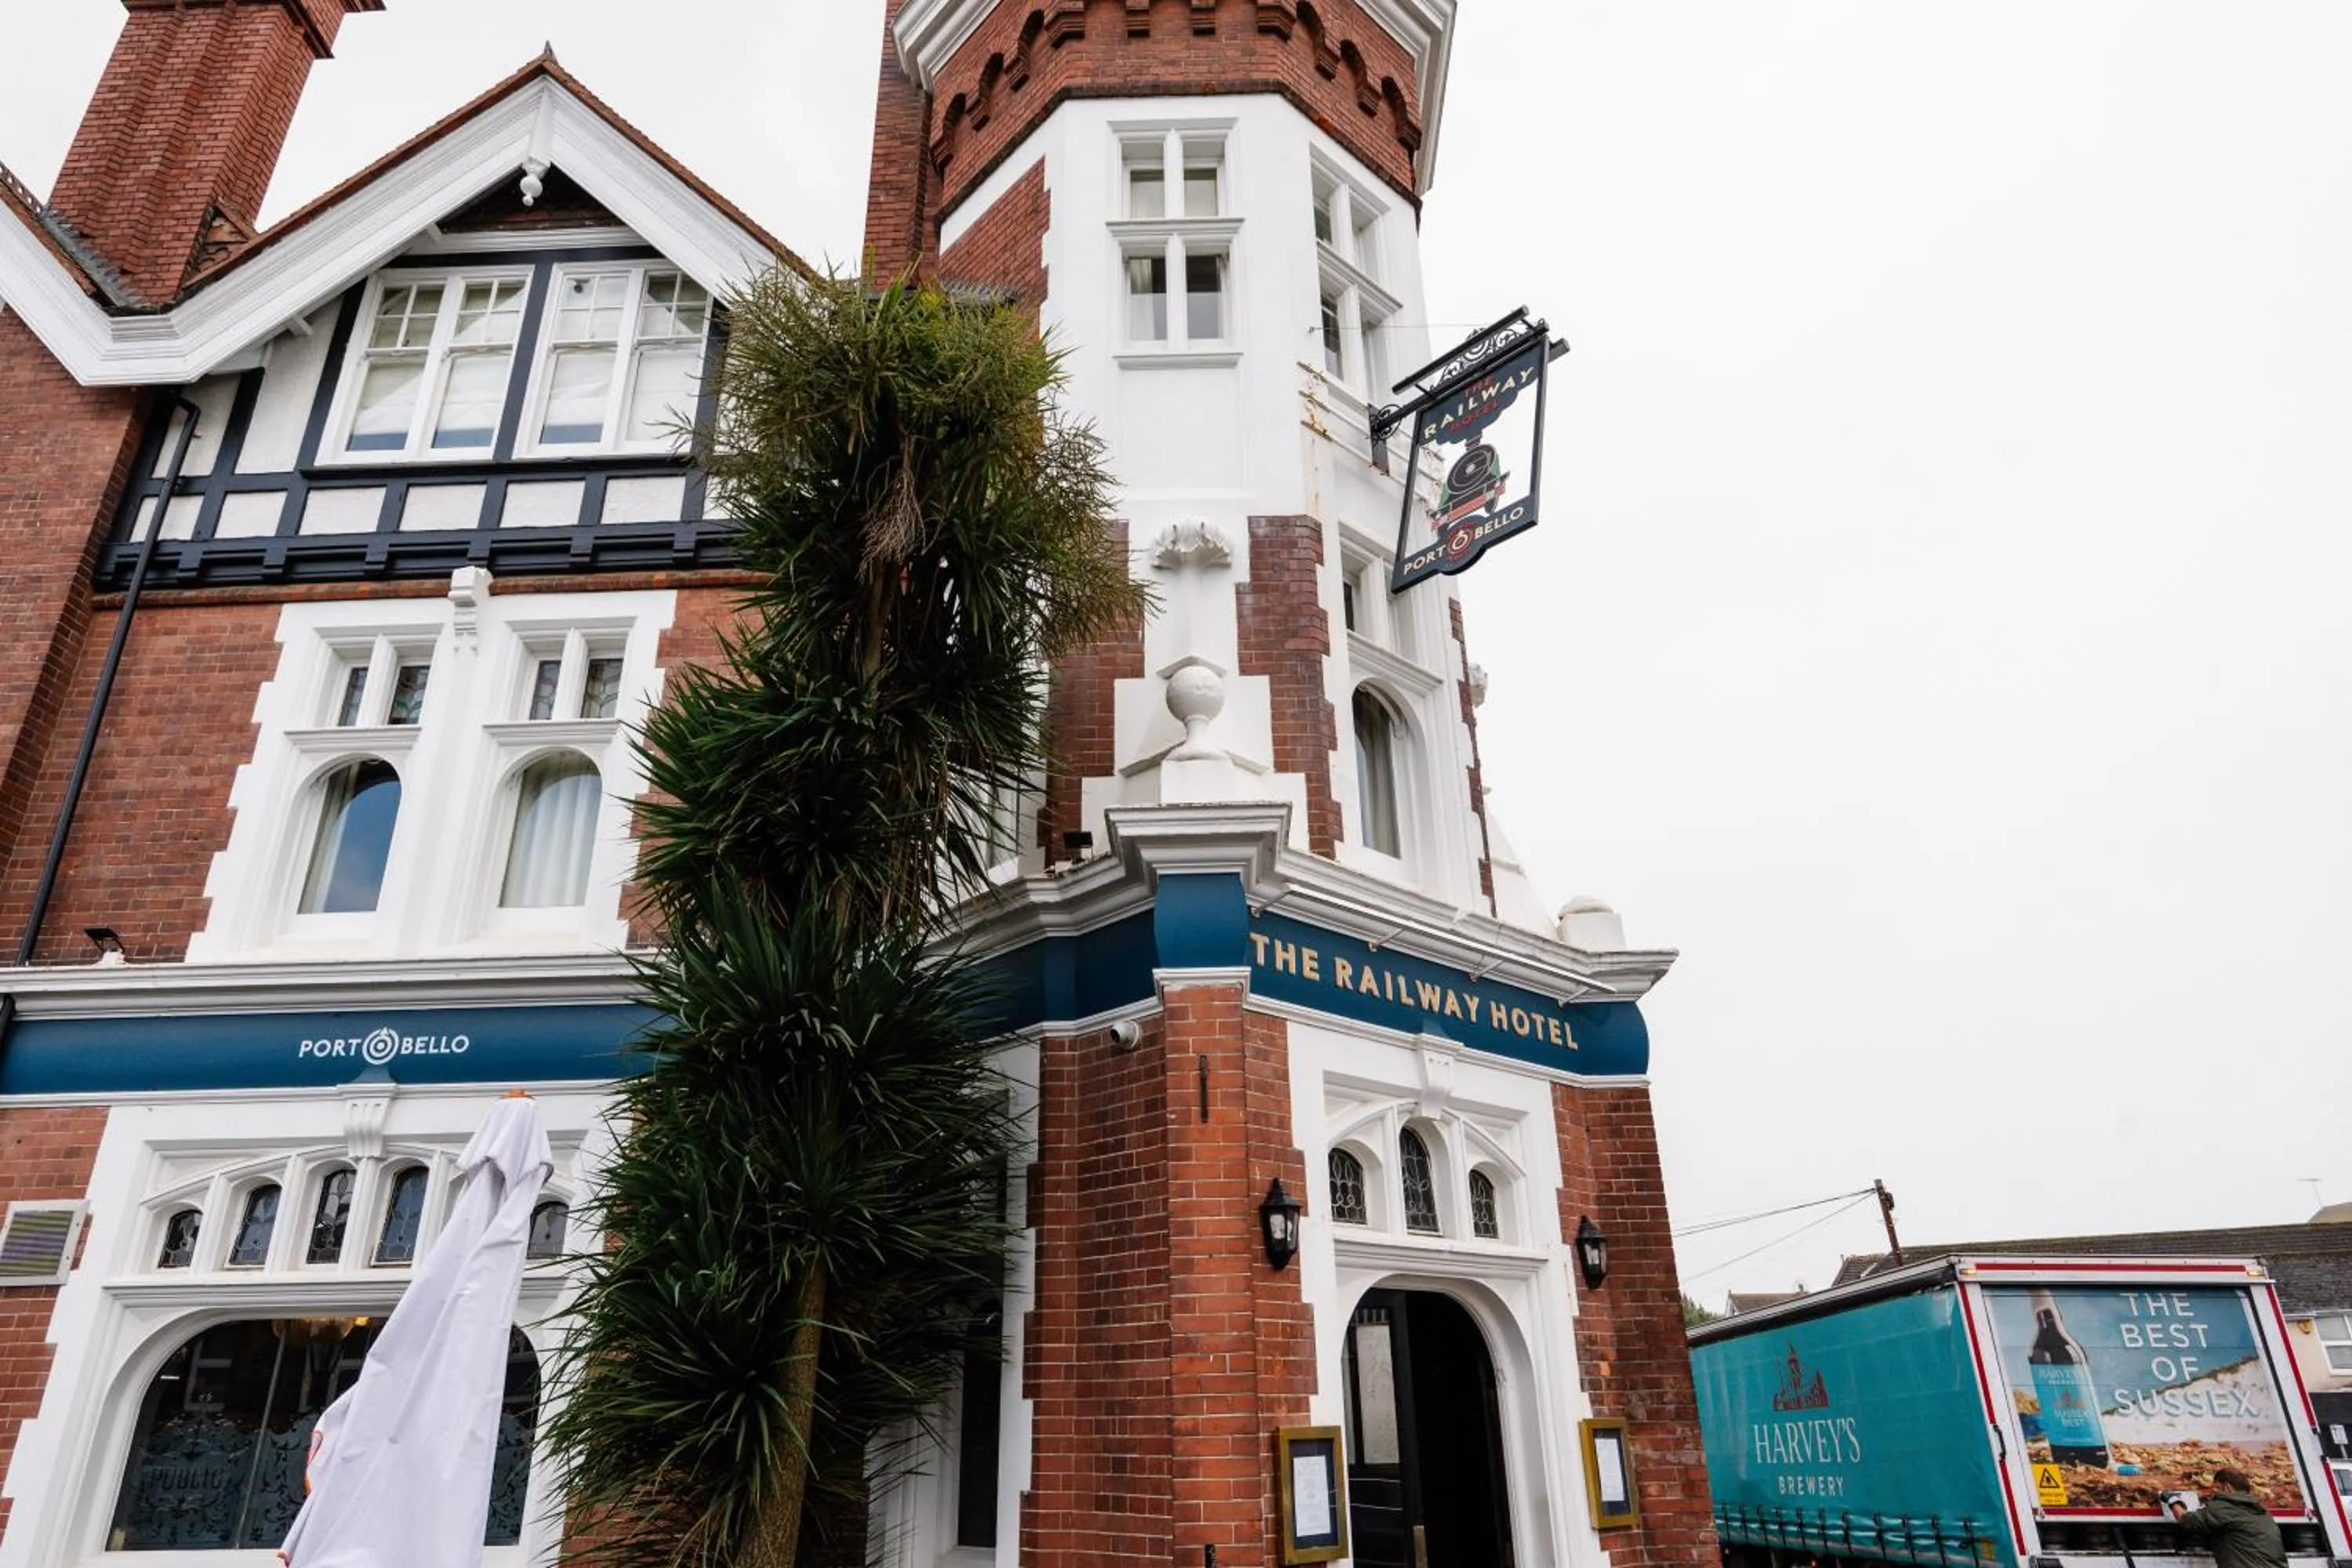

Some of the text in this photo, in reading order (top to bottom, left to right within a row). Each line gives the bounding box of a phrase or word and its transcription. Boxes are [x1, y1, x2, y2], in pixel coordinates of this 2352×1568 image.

[1464, 374, 1494, 397] THE
[1424, 366, 1534, 439] RAILWAY
[1449, 400, 1501, 434] HOTEL
[1250, 931, 1578, 1050] THE RAILWAY HOTEL
[2121, 1293, 2194, 1316] THE
[2120, 1324, 2209, 1348] BEST
[2151, 1358, 2199, 1381] OF
[2114, 1389, 2259, 1417] SUSSEX
[1753, 1417, 1860, 1464] HARVEY'S
[151, 1465, 225, 1490] PUBLIC
[1778, 1475, 1844, 1497] BREWERY
